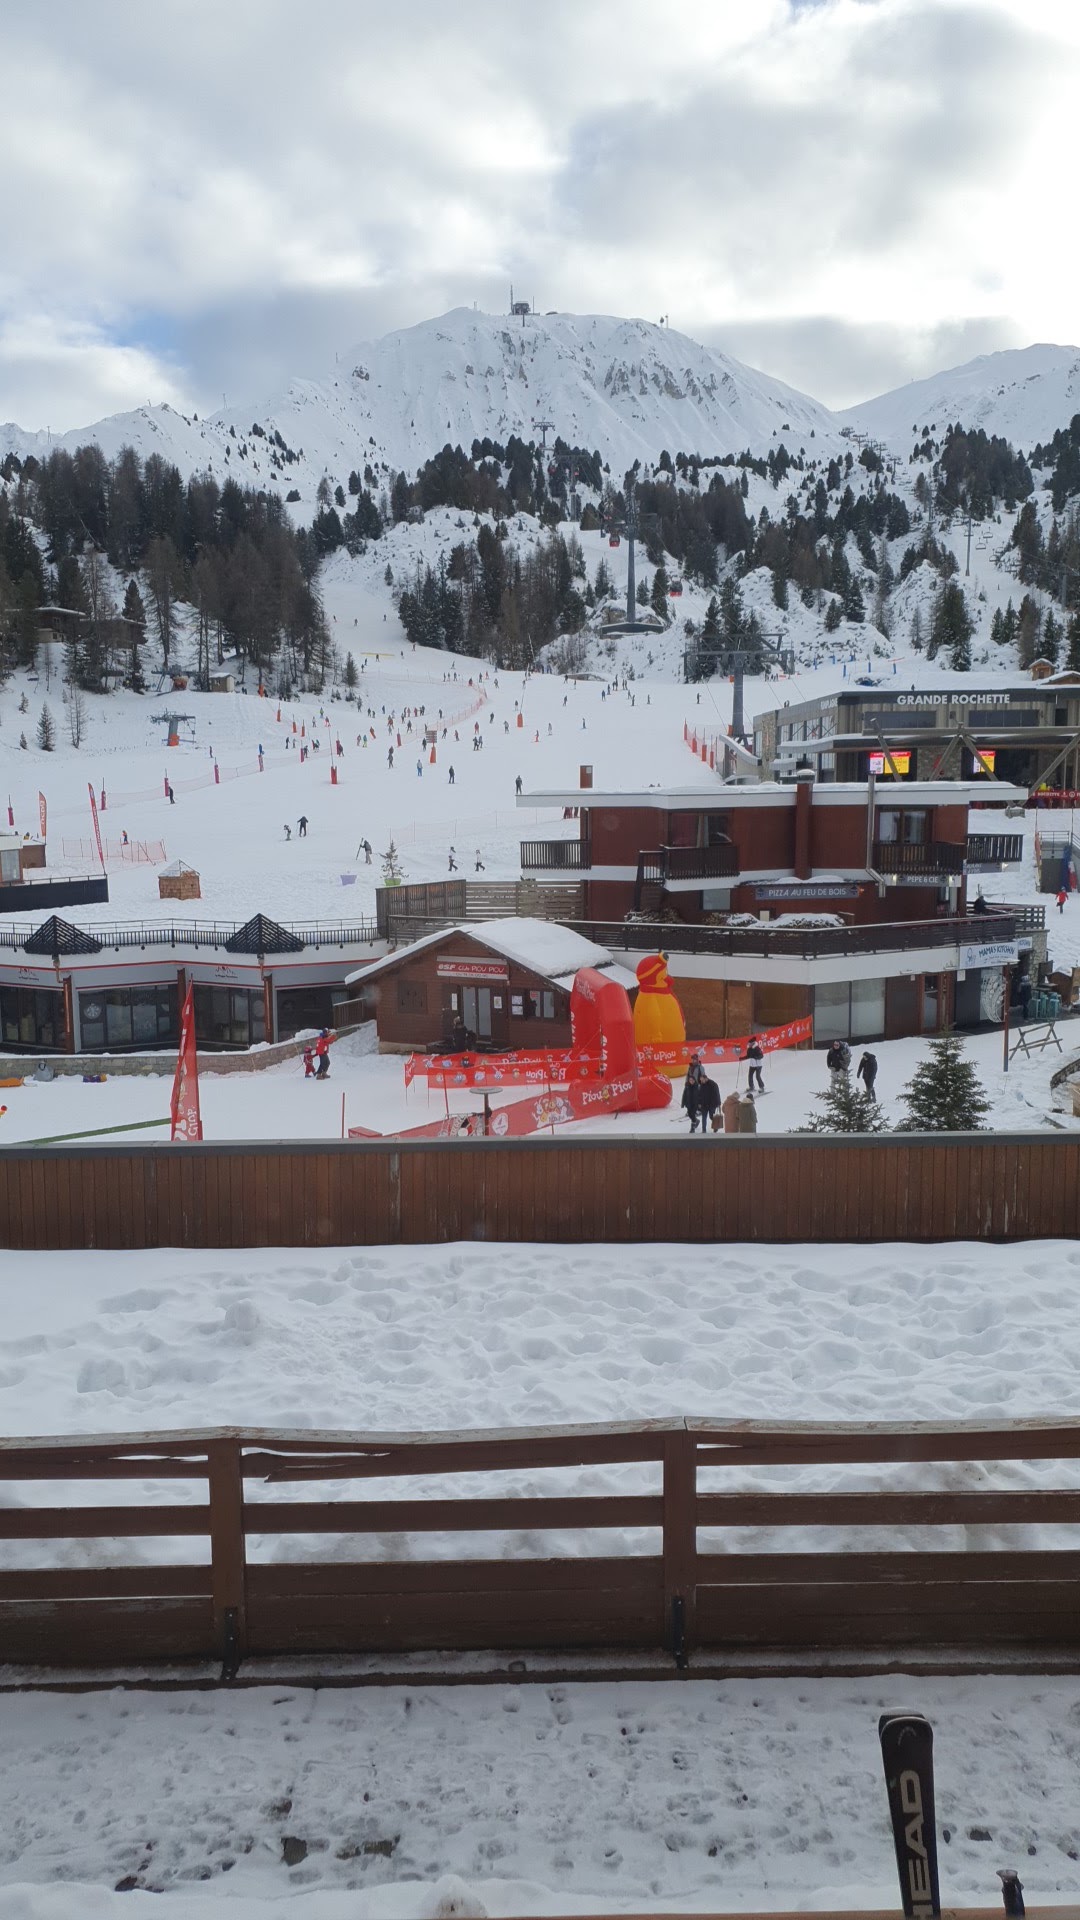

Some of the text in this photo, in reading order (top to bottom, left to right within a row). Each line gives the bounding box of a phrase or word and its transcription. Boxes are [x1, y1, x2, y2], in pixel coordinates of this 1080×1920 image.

[897, 694, 1010, 705] GRANDE ROCHETTE
[768, 889, 789, 897] PIZZA
[803, 888, 816, 896] FEU
[817, 888, 827, 896] DE
[829, 888, 846, 896] BOIS
[979, 946, 996, 957] MAMA'S
[582, 1080, 633, 1105] Piou Piou
